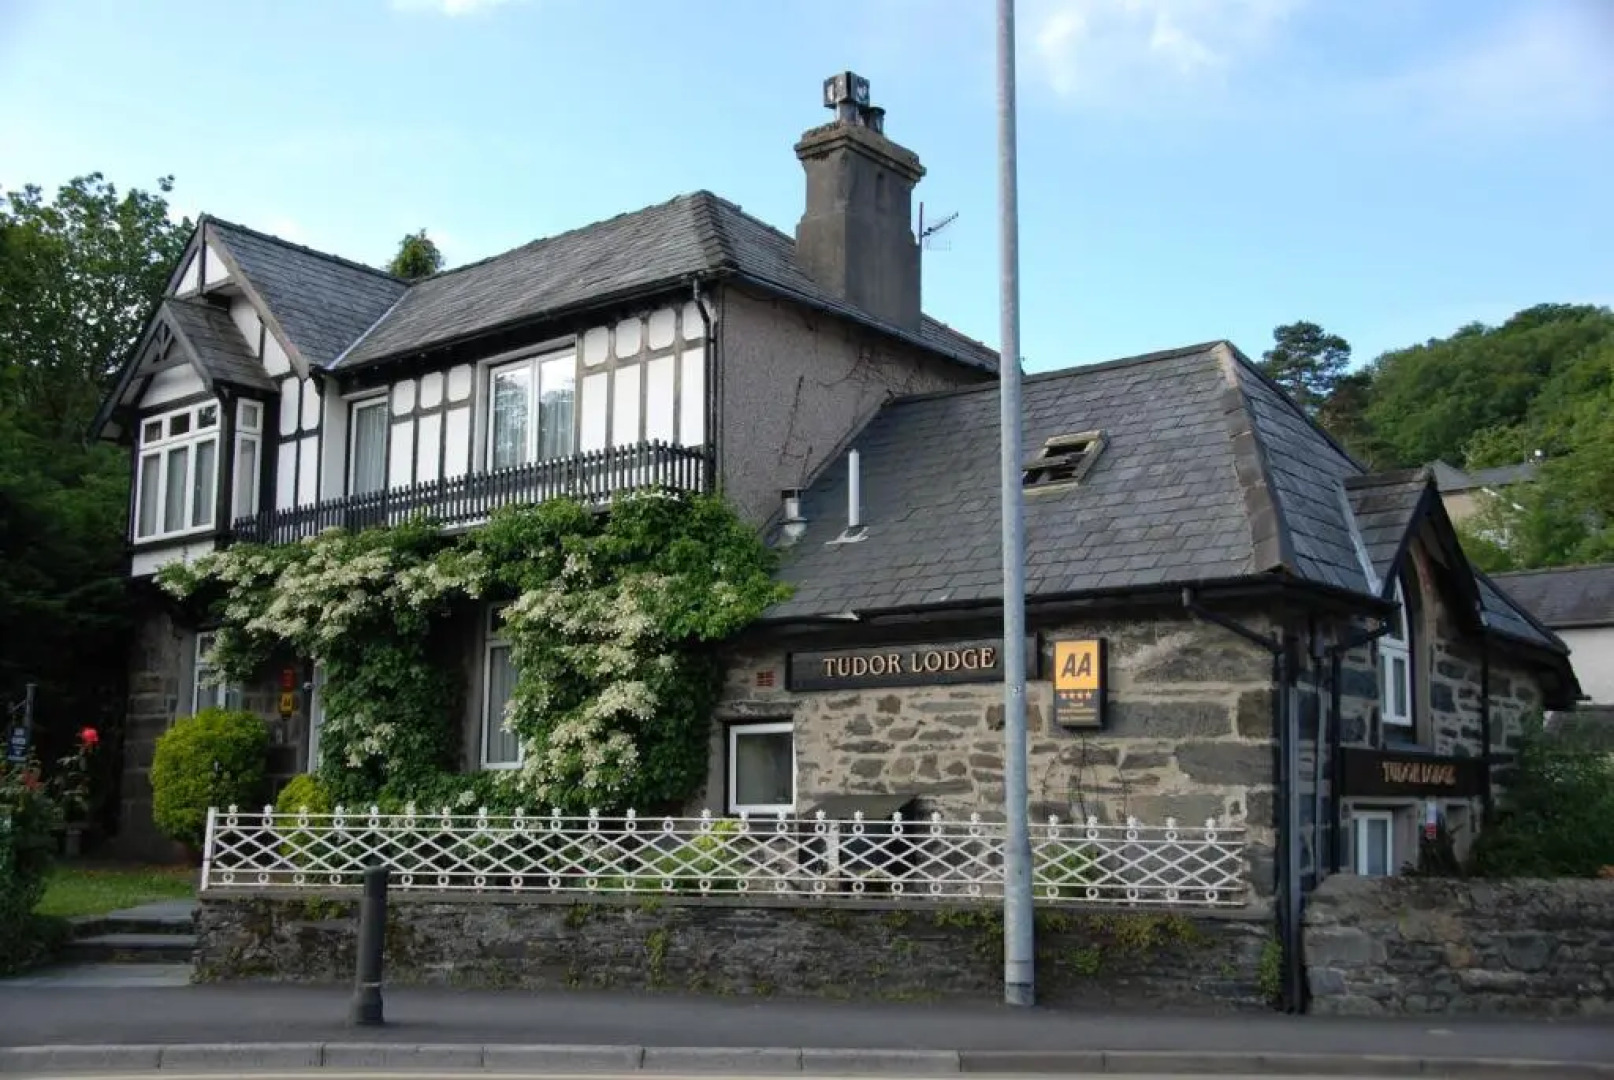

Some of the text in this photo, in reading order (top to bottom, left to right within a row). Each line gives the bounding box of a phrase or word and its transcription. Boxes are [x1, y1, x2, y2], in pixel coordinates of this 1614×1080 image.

[823, 647, 996, 677] TUDOR LODGE
[1061, 652, 1091, 678] AA
